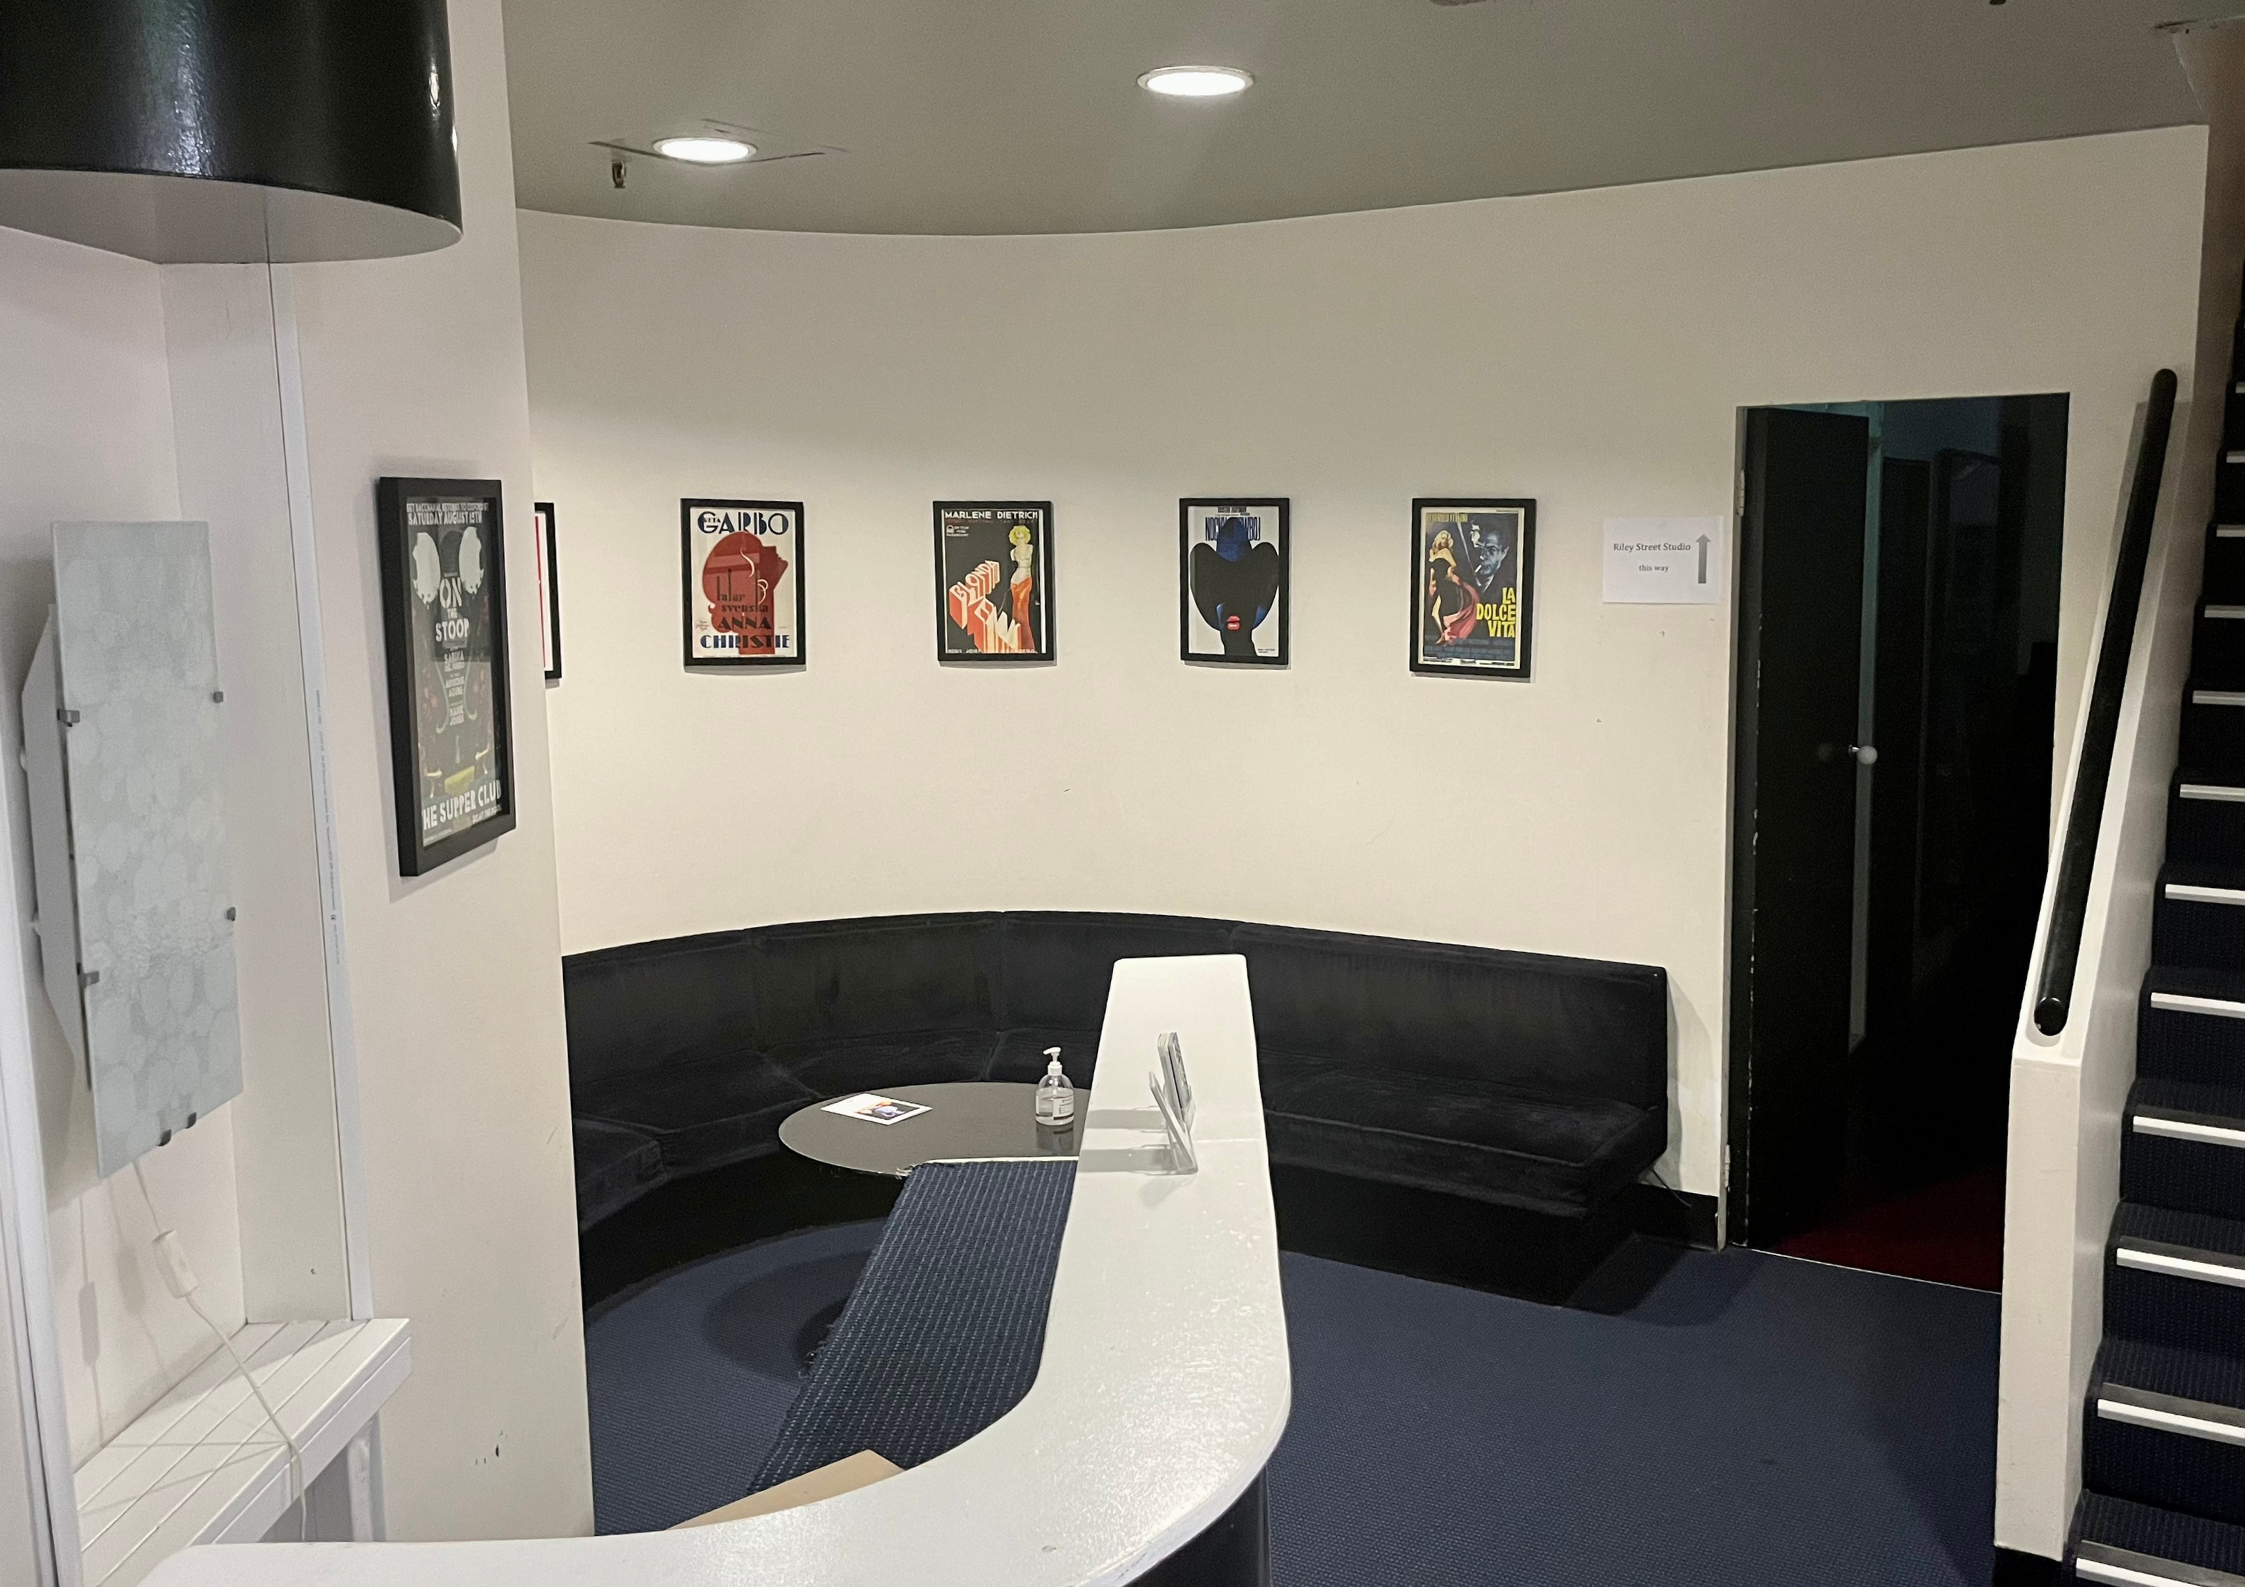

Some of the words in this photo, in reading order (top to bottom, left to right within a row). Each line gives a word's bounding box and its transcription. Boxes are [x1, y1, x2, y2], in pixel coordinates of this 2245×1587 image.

[408, 511, 443, 525] SATURDAY
[444, 511, 468, 525] AUGUST
[698, 511, 789, 535] GARBO
[945, 511, 992, 519] MARLENE
[997, 511, 1038, 519] DIETRICH
[1614, 543, 1634, 553] Riley
[1636, 543, 1661, 551] Street
[1663, 543, 1691, 551] Studio
[440, 577, 462, 608] ON
[1502, 587, 1516, 604] LA
[1476, 602, 1516, 622] DOLCE
[435, 618, 469, 642] STOOP
[718, 616, 772, 629] ANNA
[1488, 621, 1516, 638] VITA
[700, 634, 790, 648] CHRISTIE
[422, 805, 437, 830] HE
[440, 790, 476, 823] SUPPER
